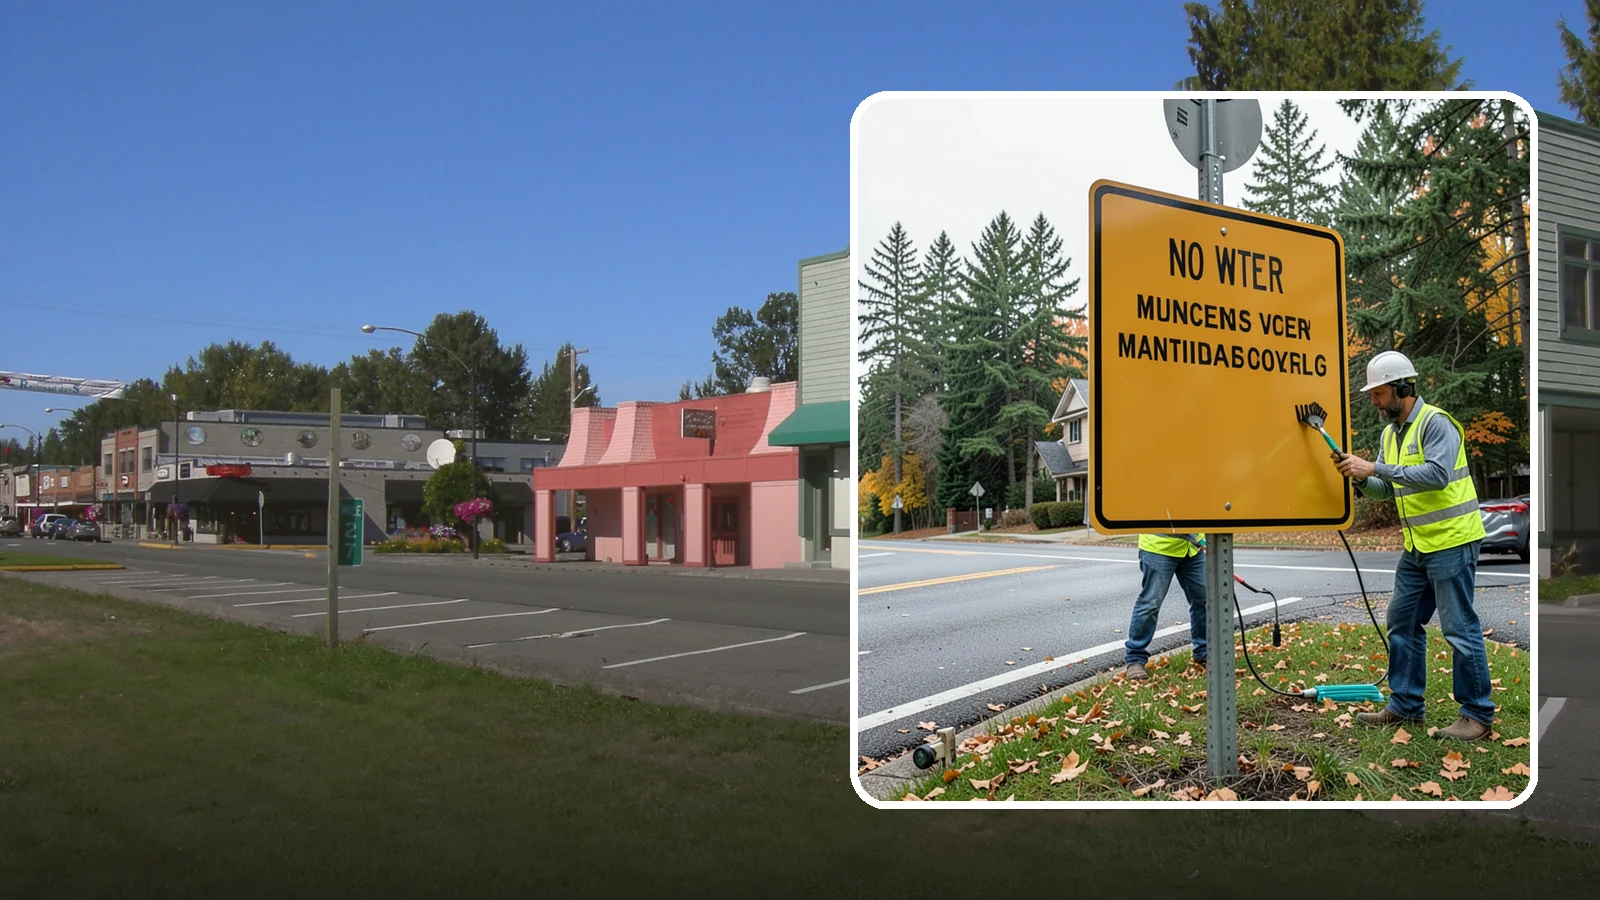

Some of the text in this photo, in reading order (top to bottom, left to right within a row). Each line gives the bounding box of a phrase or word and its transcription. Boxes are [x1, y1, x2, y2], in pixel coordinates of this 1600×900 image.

[1169, 237, 1284, 295] NO WTER
[1136, 293, 1252, 333] MUNCENS
[341, 505, 362, 517] MILE
